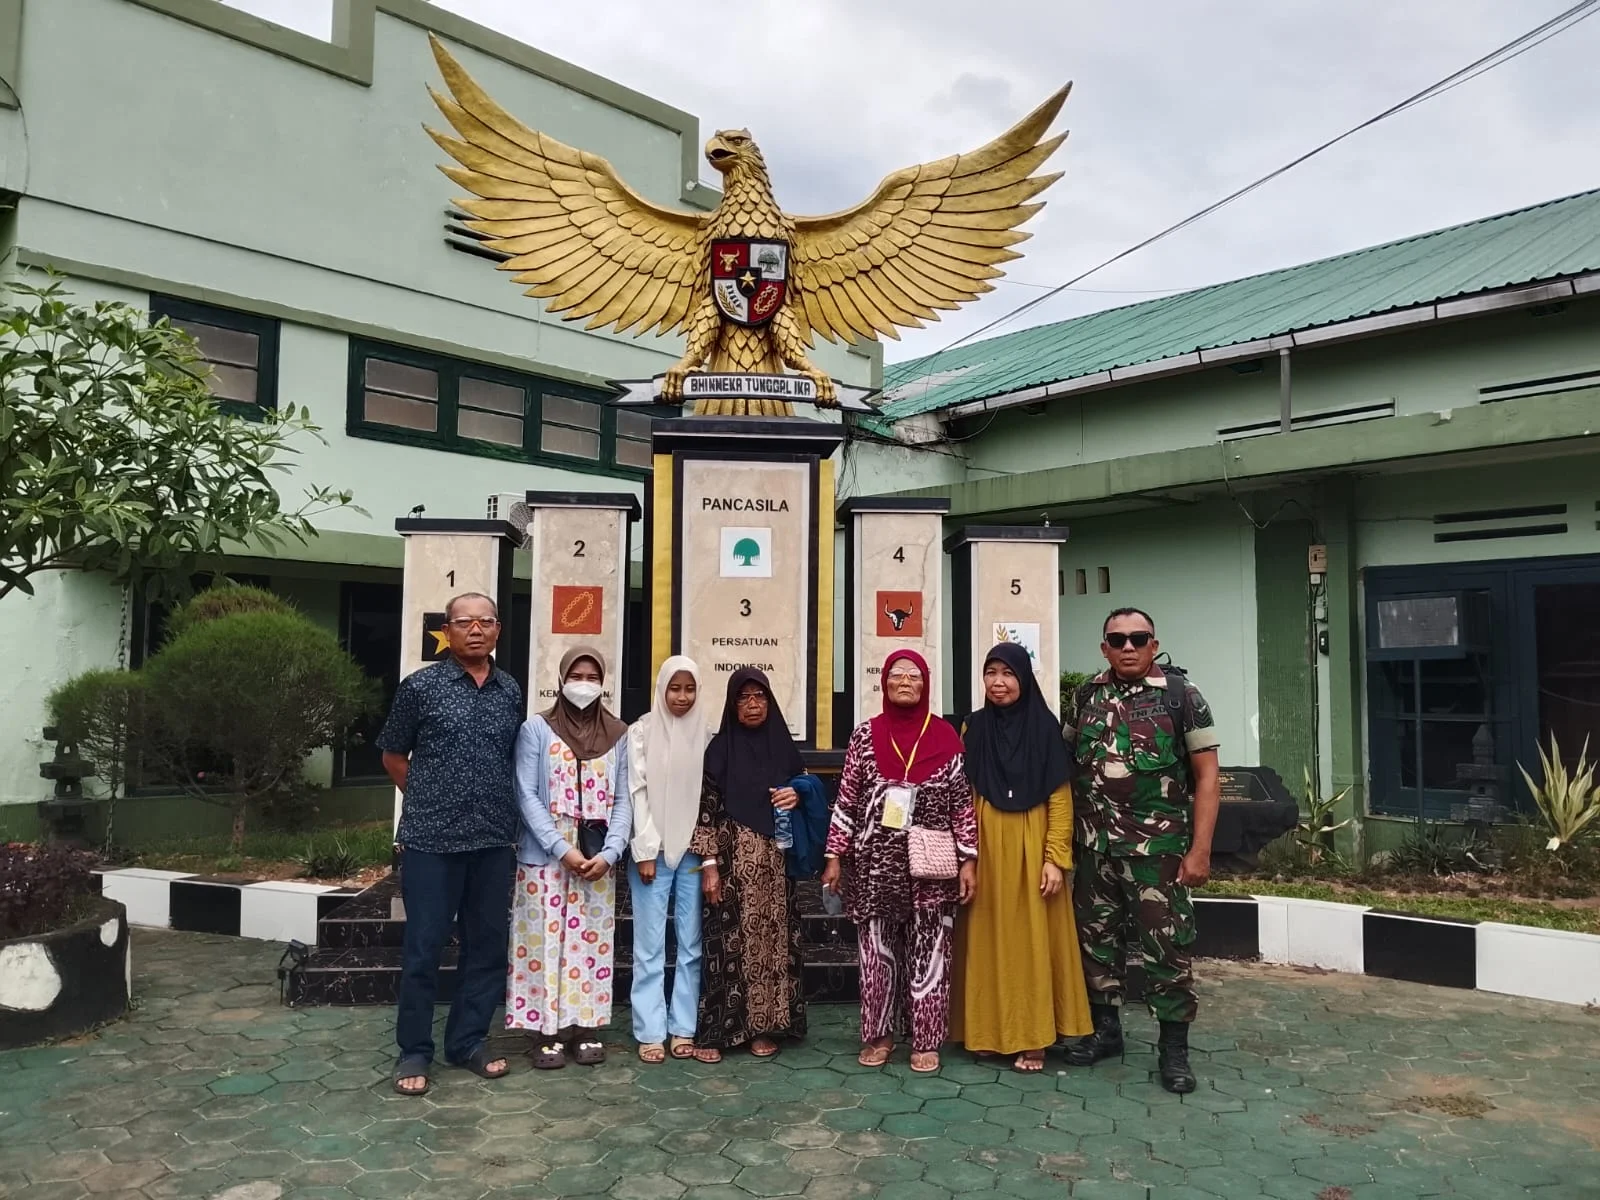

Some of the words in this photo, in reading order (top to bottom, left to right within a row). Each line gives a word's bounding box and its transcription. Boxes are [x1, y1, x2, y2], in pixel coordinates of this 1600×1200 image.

[690, 376, 742, 392] BHINNEKA
[746, 377, 792, 395] TUNGGAL
[794, 380, 811, 395] IKA
[702, 497, 790, 513] PANCASILA
[573, 540, 585, 557] 2
[892, 546, 905, 563] 4
[446, 570, 455, 588] 1
[1010, 578, 1022, 596] 5
[739, 598, 752, 617] 3
[711, 637, 779, 647] PERSATUAN
[714, 663, 775, 672] INDONESIA
[1130, 709, 1148, 719] TNI
